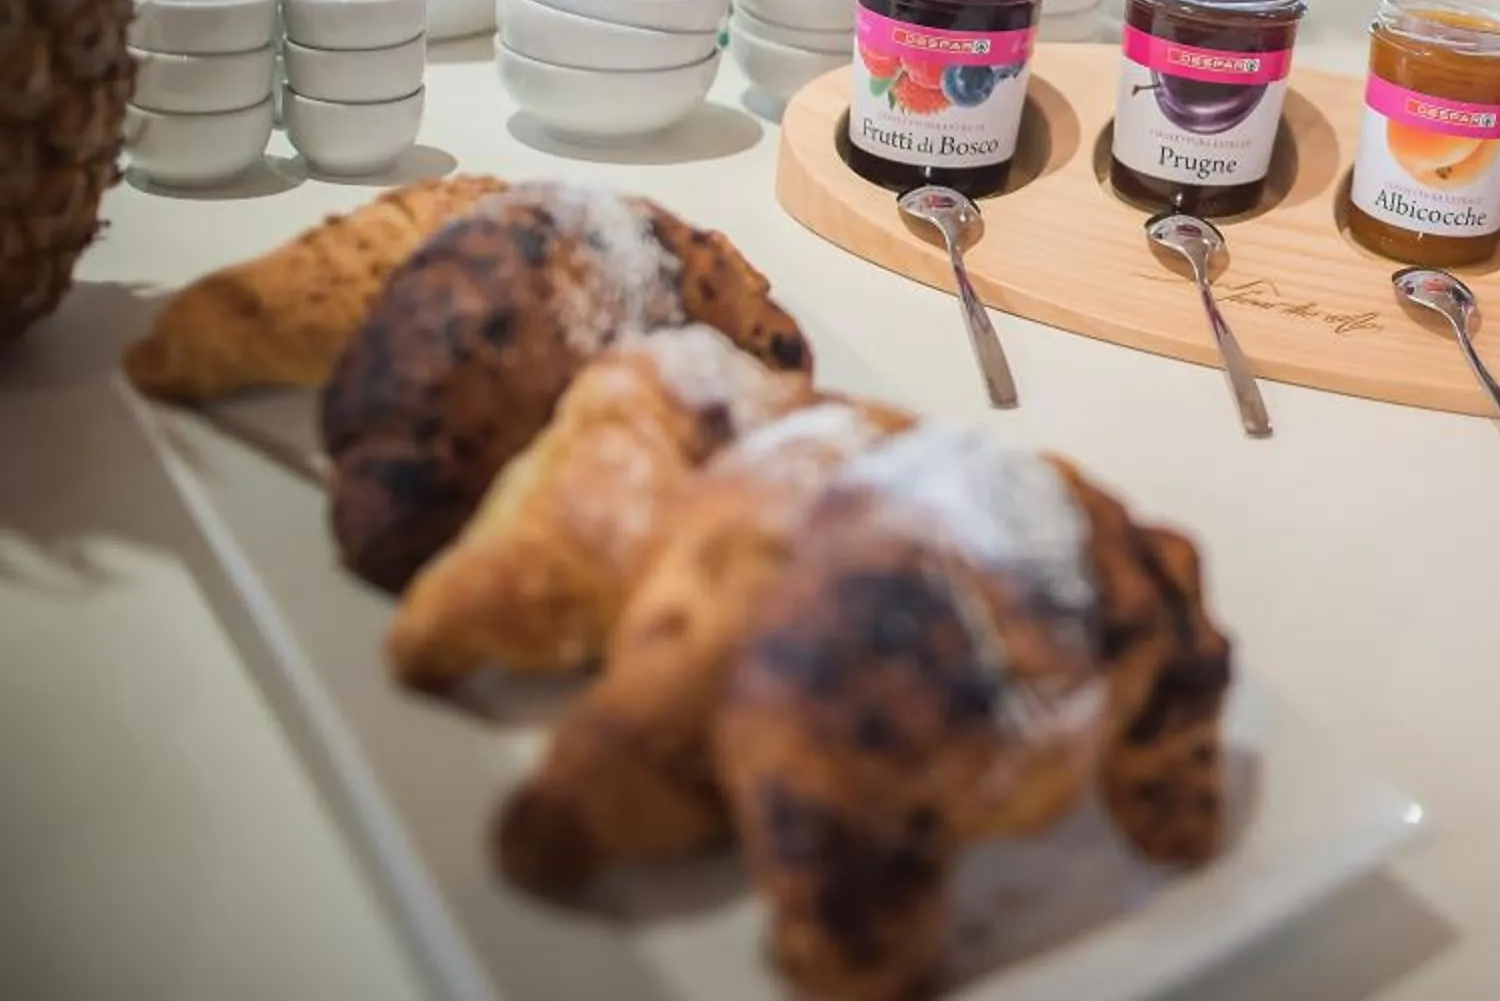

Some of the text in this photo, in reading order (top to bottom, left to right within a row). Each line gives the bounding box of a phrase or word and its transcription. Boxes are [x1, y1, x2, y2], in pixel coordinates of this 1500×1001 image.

[862, 117, 914, 152] Frutti
[916, 136, 935, 155] di
[939, 136, 1000, 156] Bosco
[1158, 145, 1238, 179] Prugne
[1374, 187, 1488, 228] Albicocche
